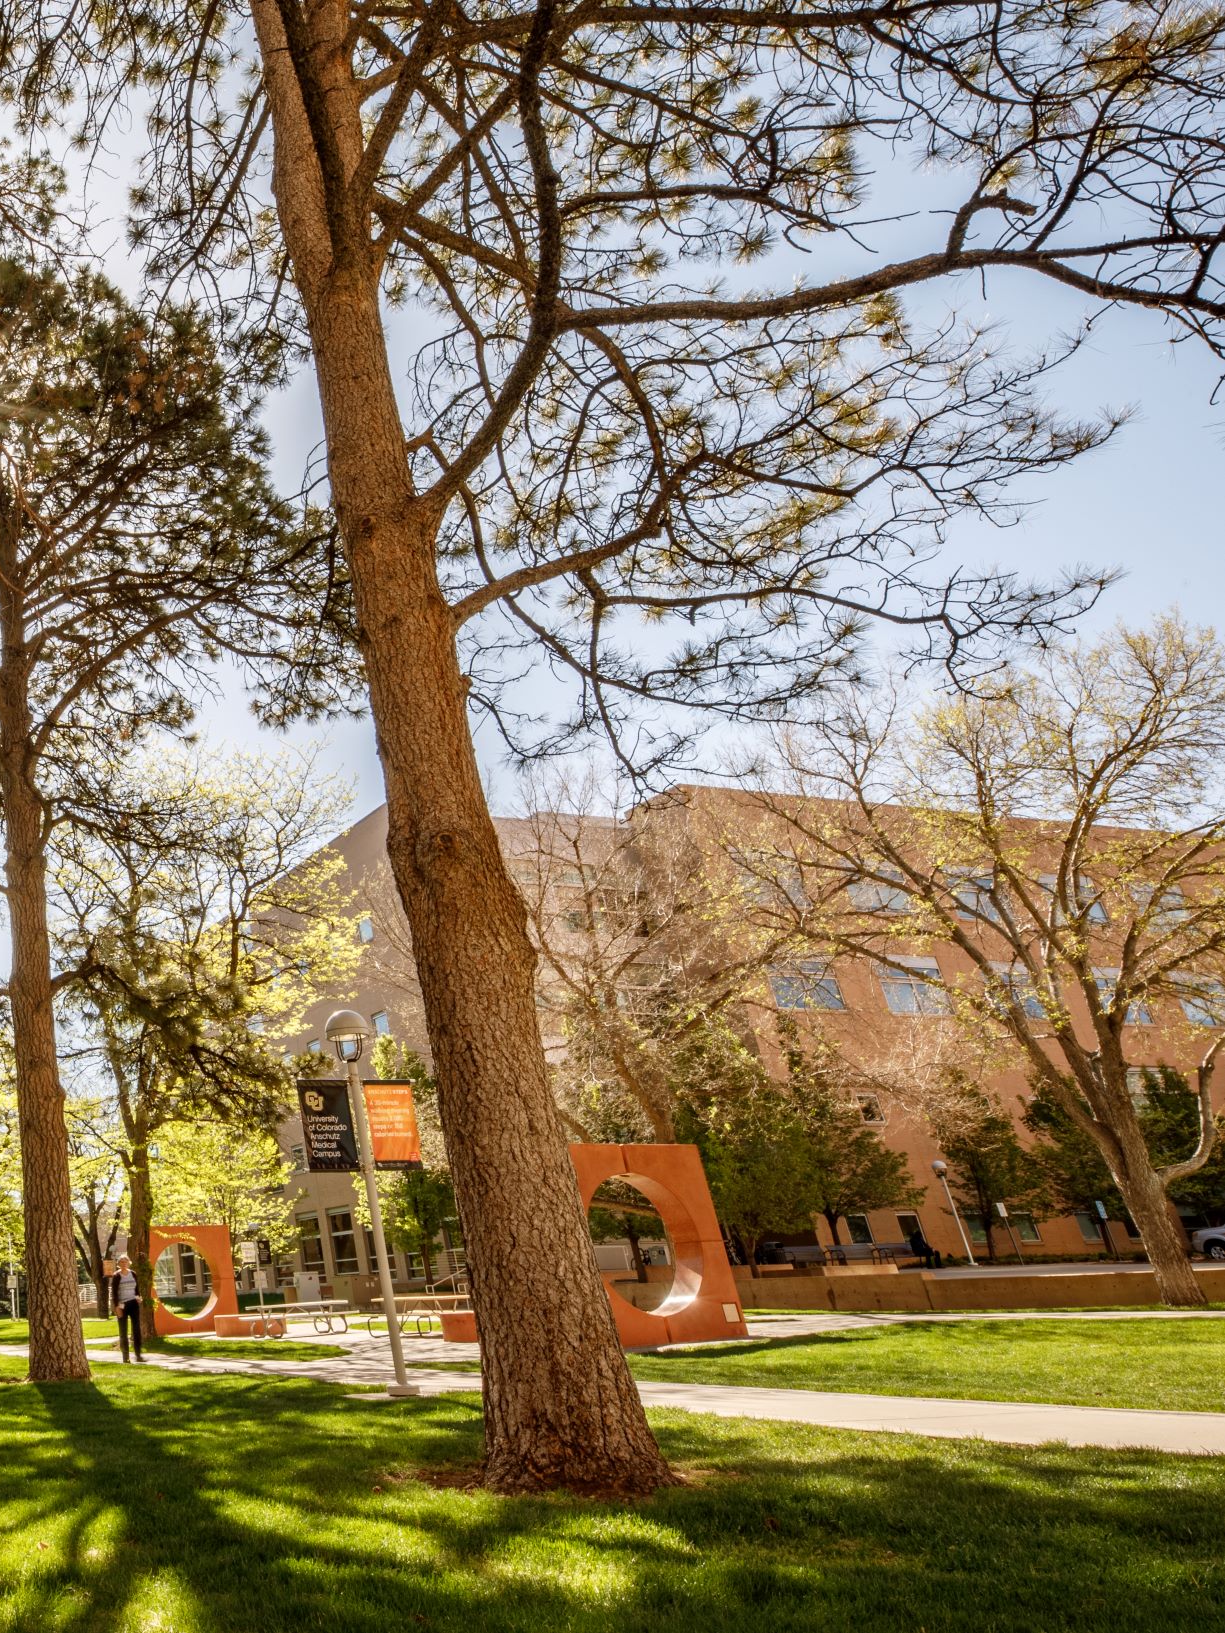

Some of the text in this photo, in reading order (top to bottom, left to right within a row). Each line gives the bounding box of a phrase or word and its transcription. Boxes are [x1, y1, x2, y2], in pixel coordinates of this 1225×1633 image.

[307, 1115, 339, 1124] University
[310, 1132, 341, 1140] Anschutz
[311, 1141, 338, 1149] Medical
[312, 1149, 342, 1158] Campus
